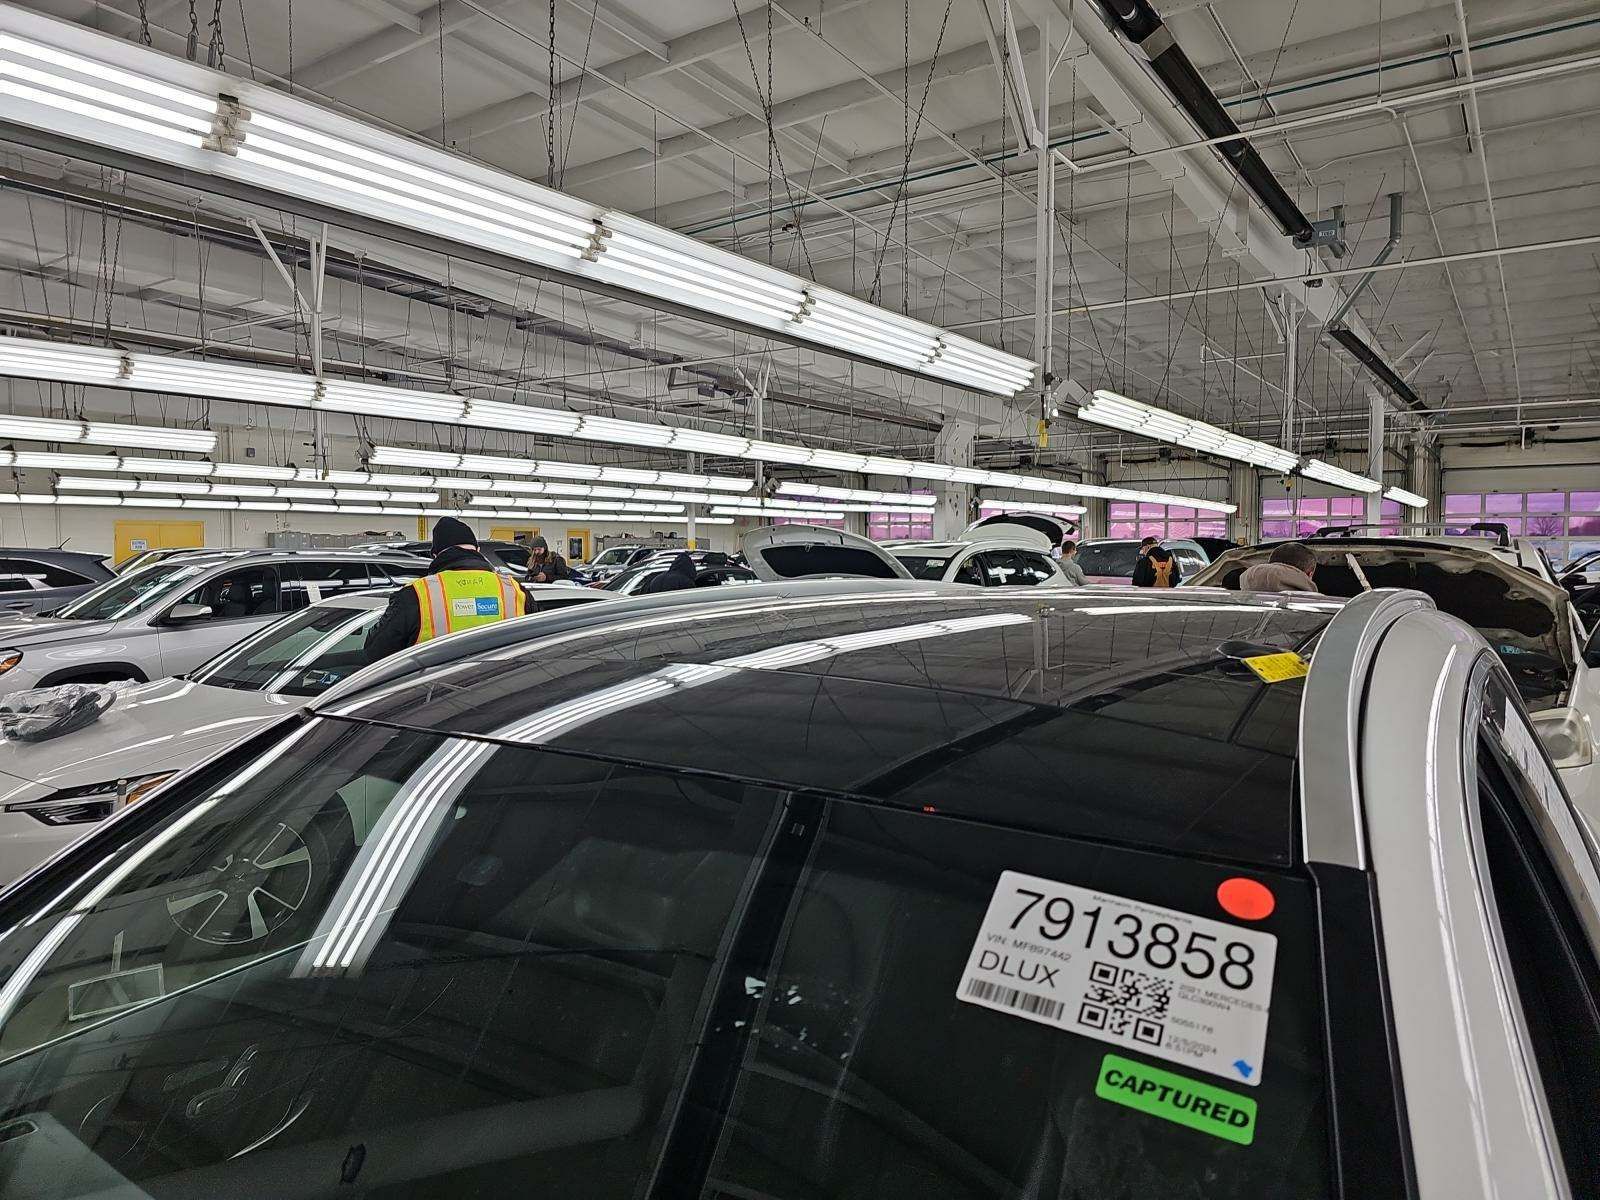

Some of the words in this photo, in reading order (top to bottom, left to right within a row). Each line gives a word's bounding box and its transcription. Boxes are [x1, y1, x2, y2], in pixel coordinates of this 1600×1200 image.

[455, 602, 474, 611] Power
[477, 602, 498, 610] Secure
[1009, 888, 1256, 991] 7913858
[979, 950, 1061, 988] DLUX
[1104, 1069, 1250, 1128] CAPTURED
